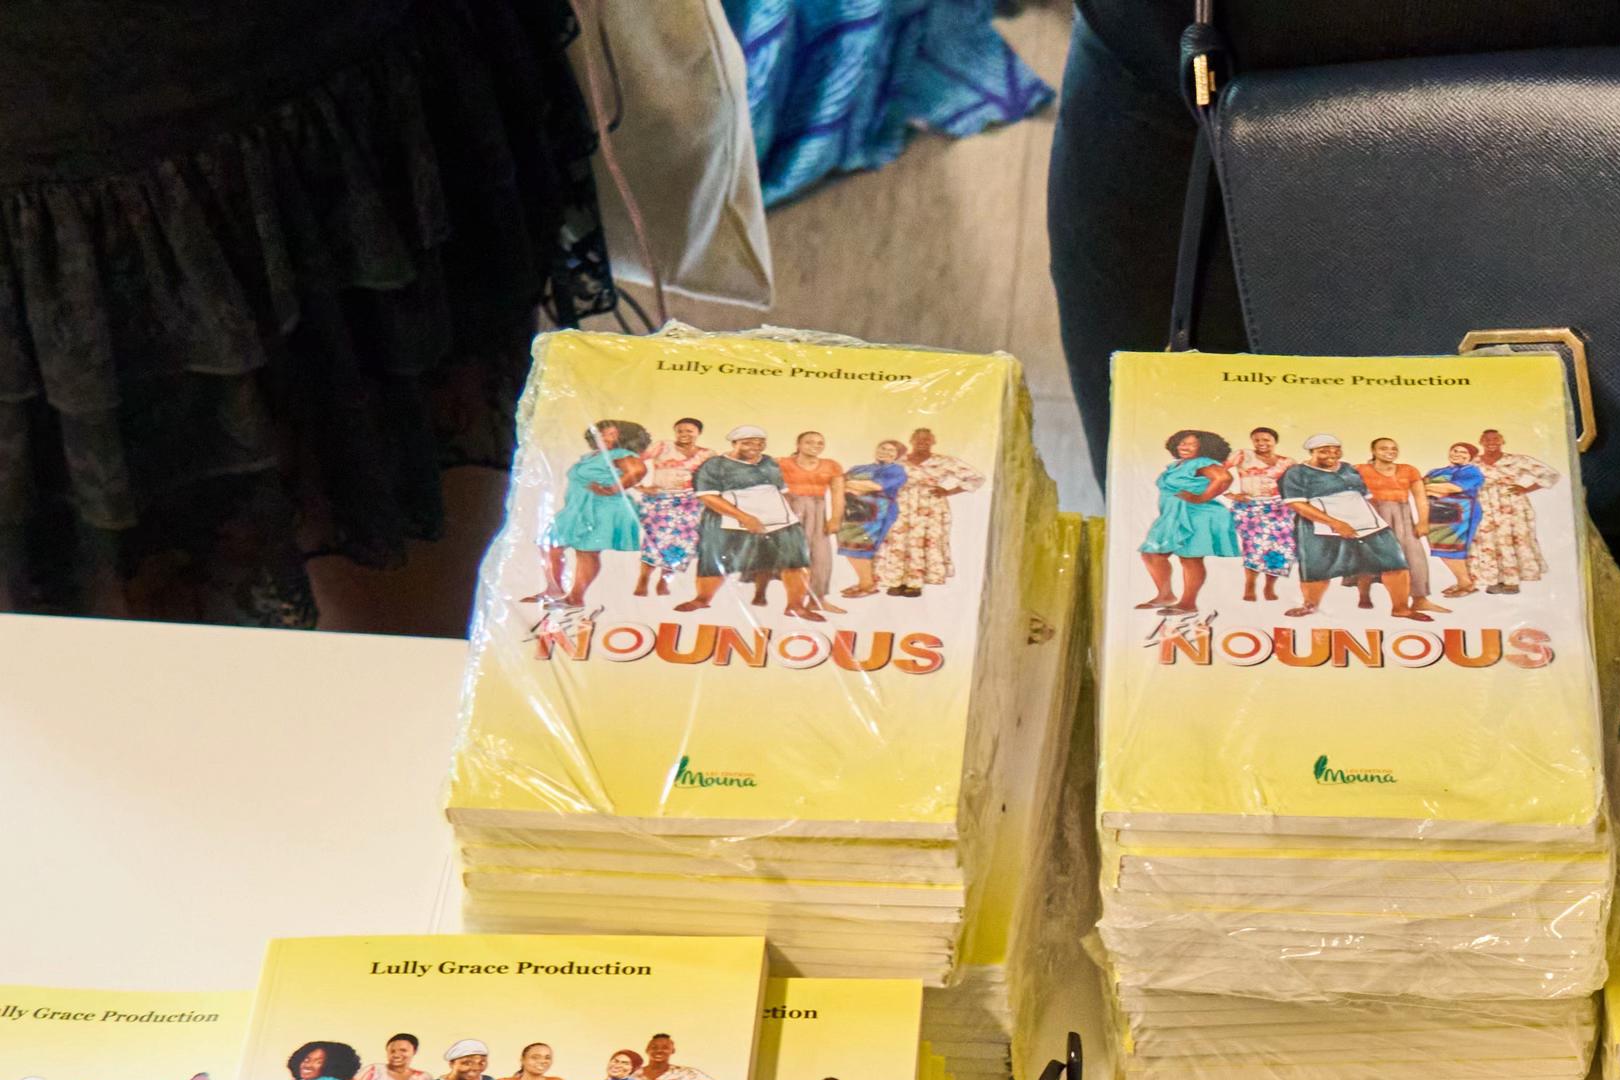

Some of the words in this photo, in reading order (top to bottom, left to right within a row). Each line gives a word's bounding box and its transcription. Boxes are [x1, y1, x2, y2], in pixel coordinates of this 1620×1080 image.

[656, 360, 713, 375] Lully
[718, 363, 783, 376] Grace
[790, 367, 912, 382] Production
[1222, 372, 1276, 385] Lully
[1282, 373, 1344, 385] Grace
[1351, 375, 1471, 386] Production
[532, 621, 945, 676] NOUNOUS
[1157, 625, 1556, 669] NOUNOUS
[680, 769, 758, 788] Mouna
[1324, 768, 1398, 784] Mouna
[369, 960, 433, 977] Lully
[438, 961, 509, 975] Grace
[516, 961, 652, 976] Production
[0, 1004, 29, 1021] lly
[33, 1007, 96, 1022] Grace
[100, 1009, 220, 1024] Production
